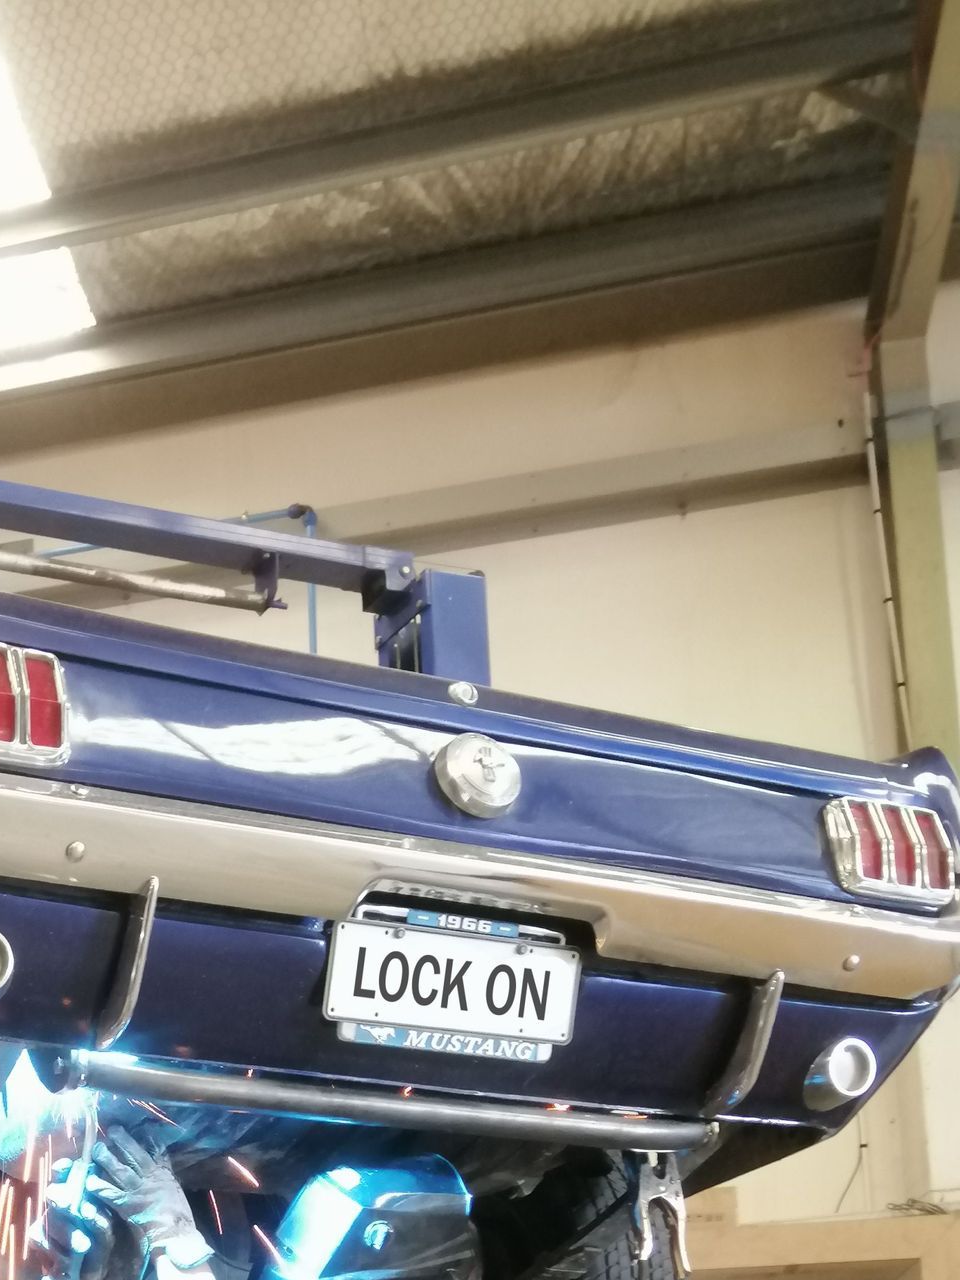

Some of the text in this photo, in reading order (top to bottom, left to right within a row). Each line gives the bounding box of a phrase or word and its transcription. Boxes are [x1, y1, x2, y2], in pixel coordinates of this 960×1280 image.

[438, 914, 493, 934] 1966
[353, 947, 551, 1021] LOCK ON
[403, 1030, 535, 1061] MUSTANG
